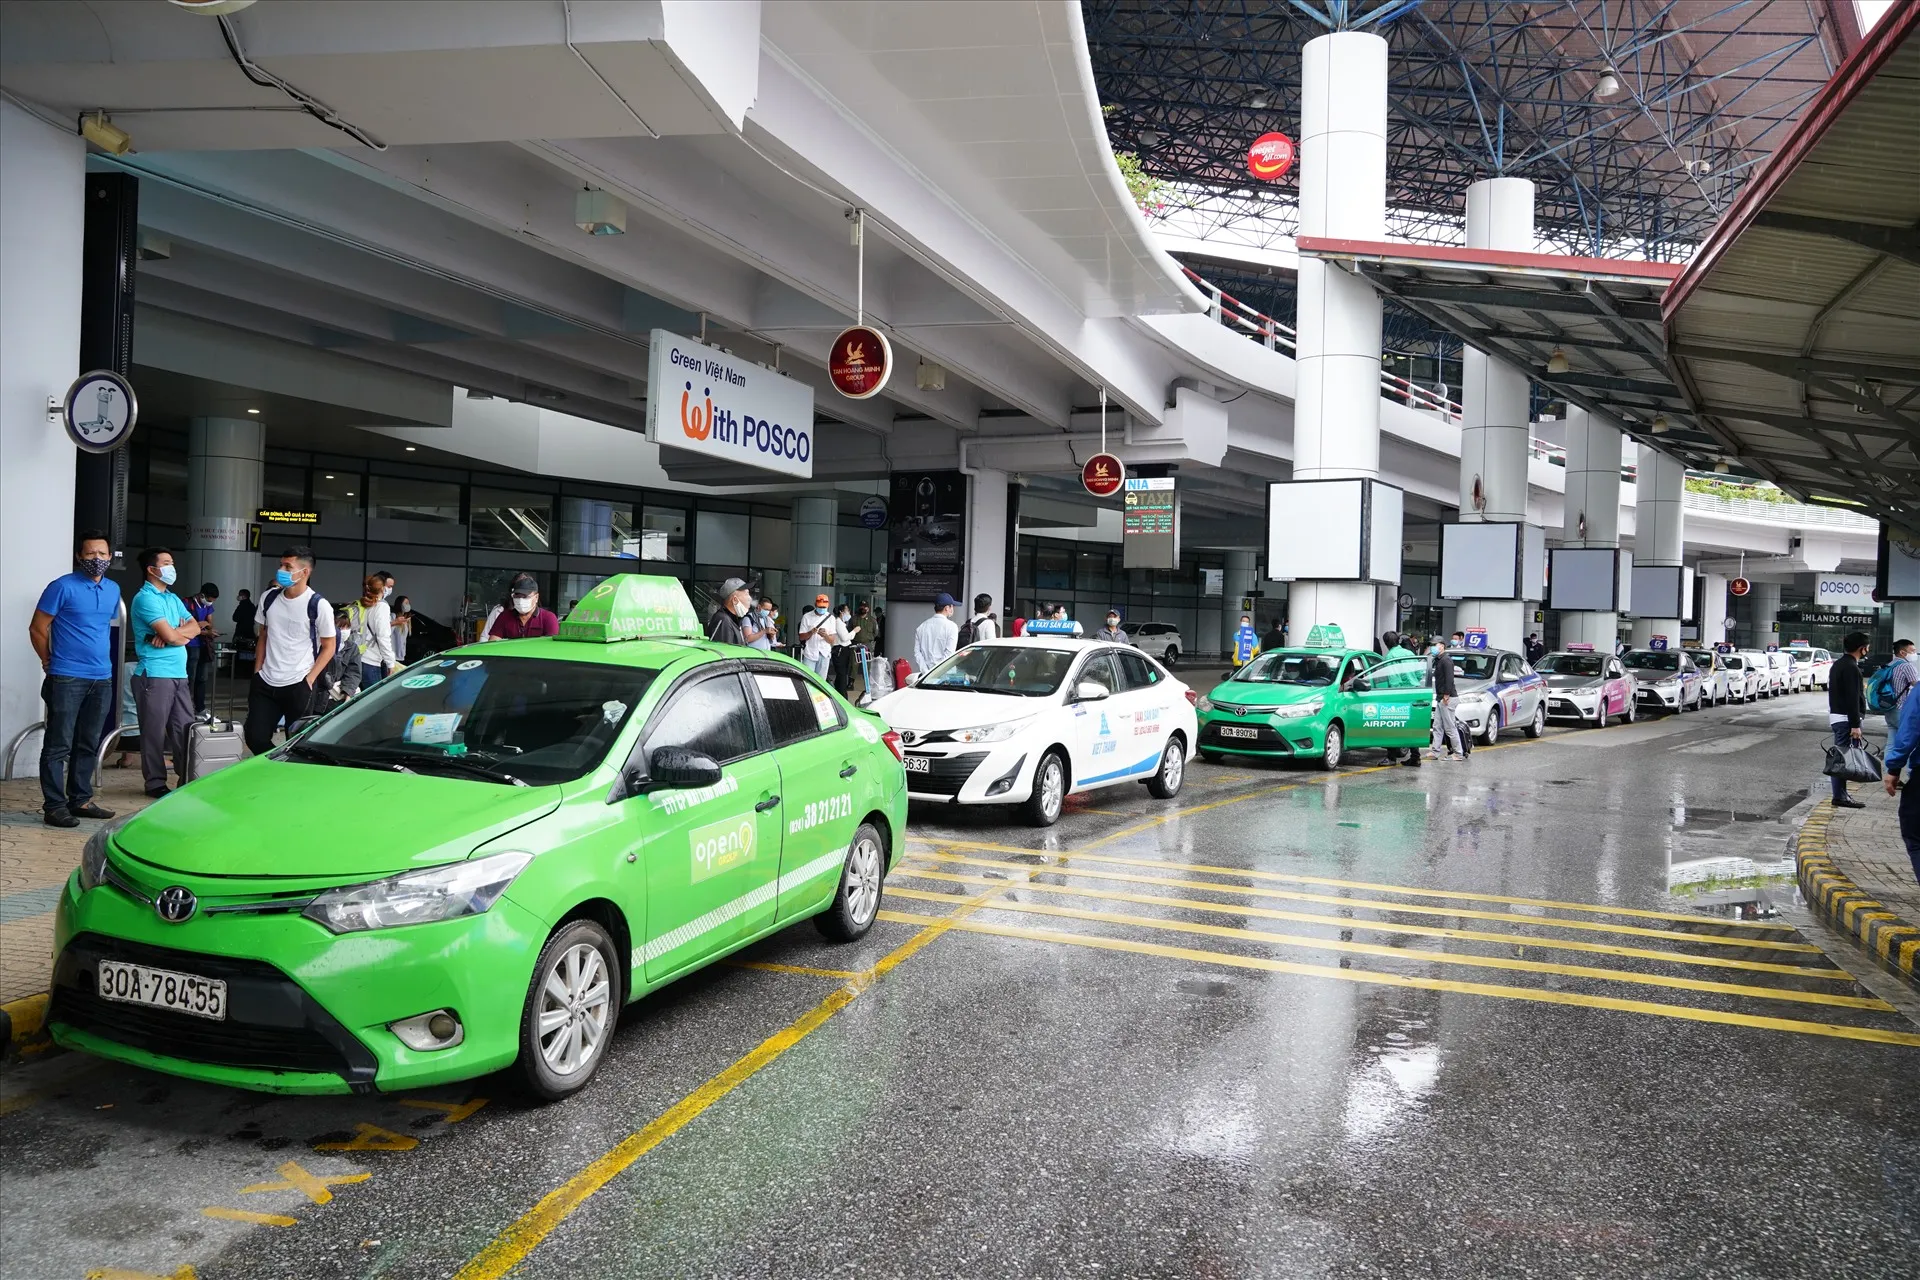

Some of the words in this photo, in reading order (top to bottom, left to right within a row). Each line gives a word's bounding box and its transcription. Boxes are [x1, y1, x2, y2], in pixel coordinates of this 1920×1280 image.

[670, 347, 702, 372] Green
[704, 359, 724, 382] Việt
[725, 369, 746, 388] Nam
[846, 374, 865, 382] GROUP
[743, 415, 810, 463] POSCO
[1128, 480, 1149, 489] NIA
[1137, 493, 1173, 505] TAXI
[252, 528, 260, 548] 7
[826, 570, 833, 584] 6
[1244, 600, 1250, 609] 4
[1536, 613, 1542, 621] 3
[1842, 614, 1872, 624] COFFEE
[612, 618, 672, 631] AIRPORT
[1470, 635, 1482, 646] G7
[1363, 720, 1407, 728] AIRPORT
[102, 966, 220, 1014] 30A-784.55
